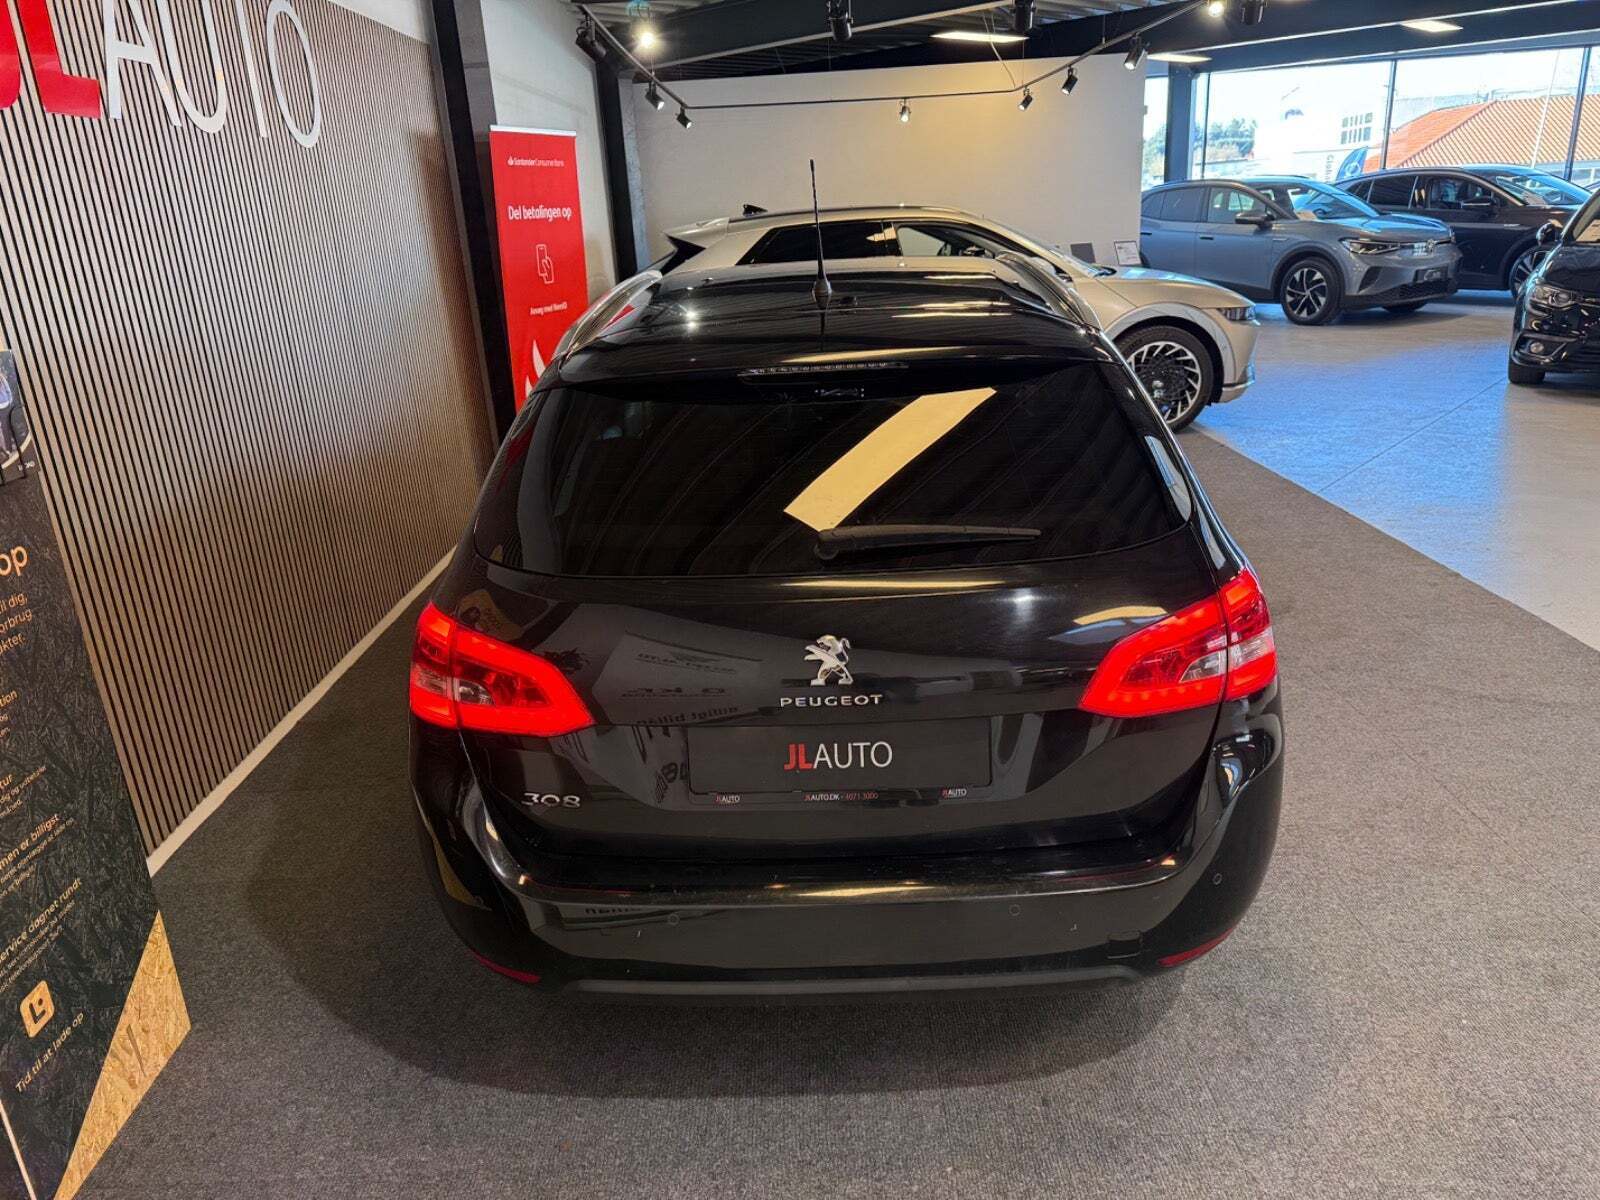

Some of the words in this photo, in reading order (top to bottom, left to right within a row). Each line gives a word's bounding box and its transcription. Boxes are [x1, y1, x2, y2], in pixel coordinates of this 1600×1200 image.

[508, 205, 522, 220] Del
[522, 205, 561, 222] betalingen
[562, 207, 572, 221] op
[0, 546, 28, 576] op
[780, 694, 883, 708] PEUGEOT
[784, 741, 893, 771] JLAUTO
[521, 792, 581, 808] 308
[16, 1071, 32, 1093] Tid
[53, 1026, 72, 1052] lade
[72, 1012, 84, 1028] op
